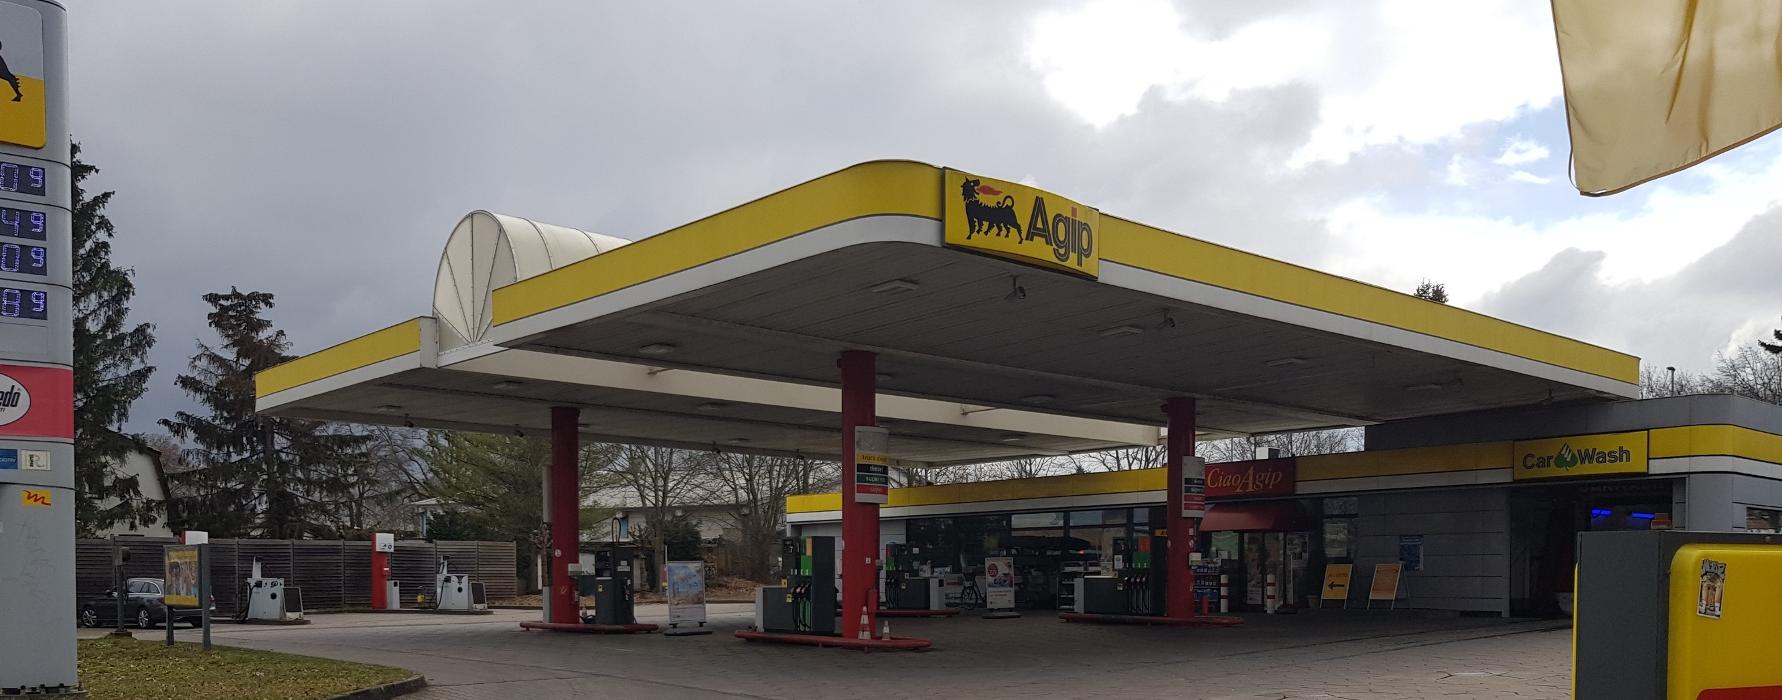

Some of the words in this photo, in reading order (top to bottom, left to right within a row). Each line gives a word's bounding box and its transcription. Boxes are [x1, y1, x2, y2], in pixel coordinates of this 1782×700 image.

[1025, 196, 1092, 267] Agip
[1522, 453, 1553, 470] Car
[1577, 446, 1631, 464] Wash
